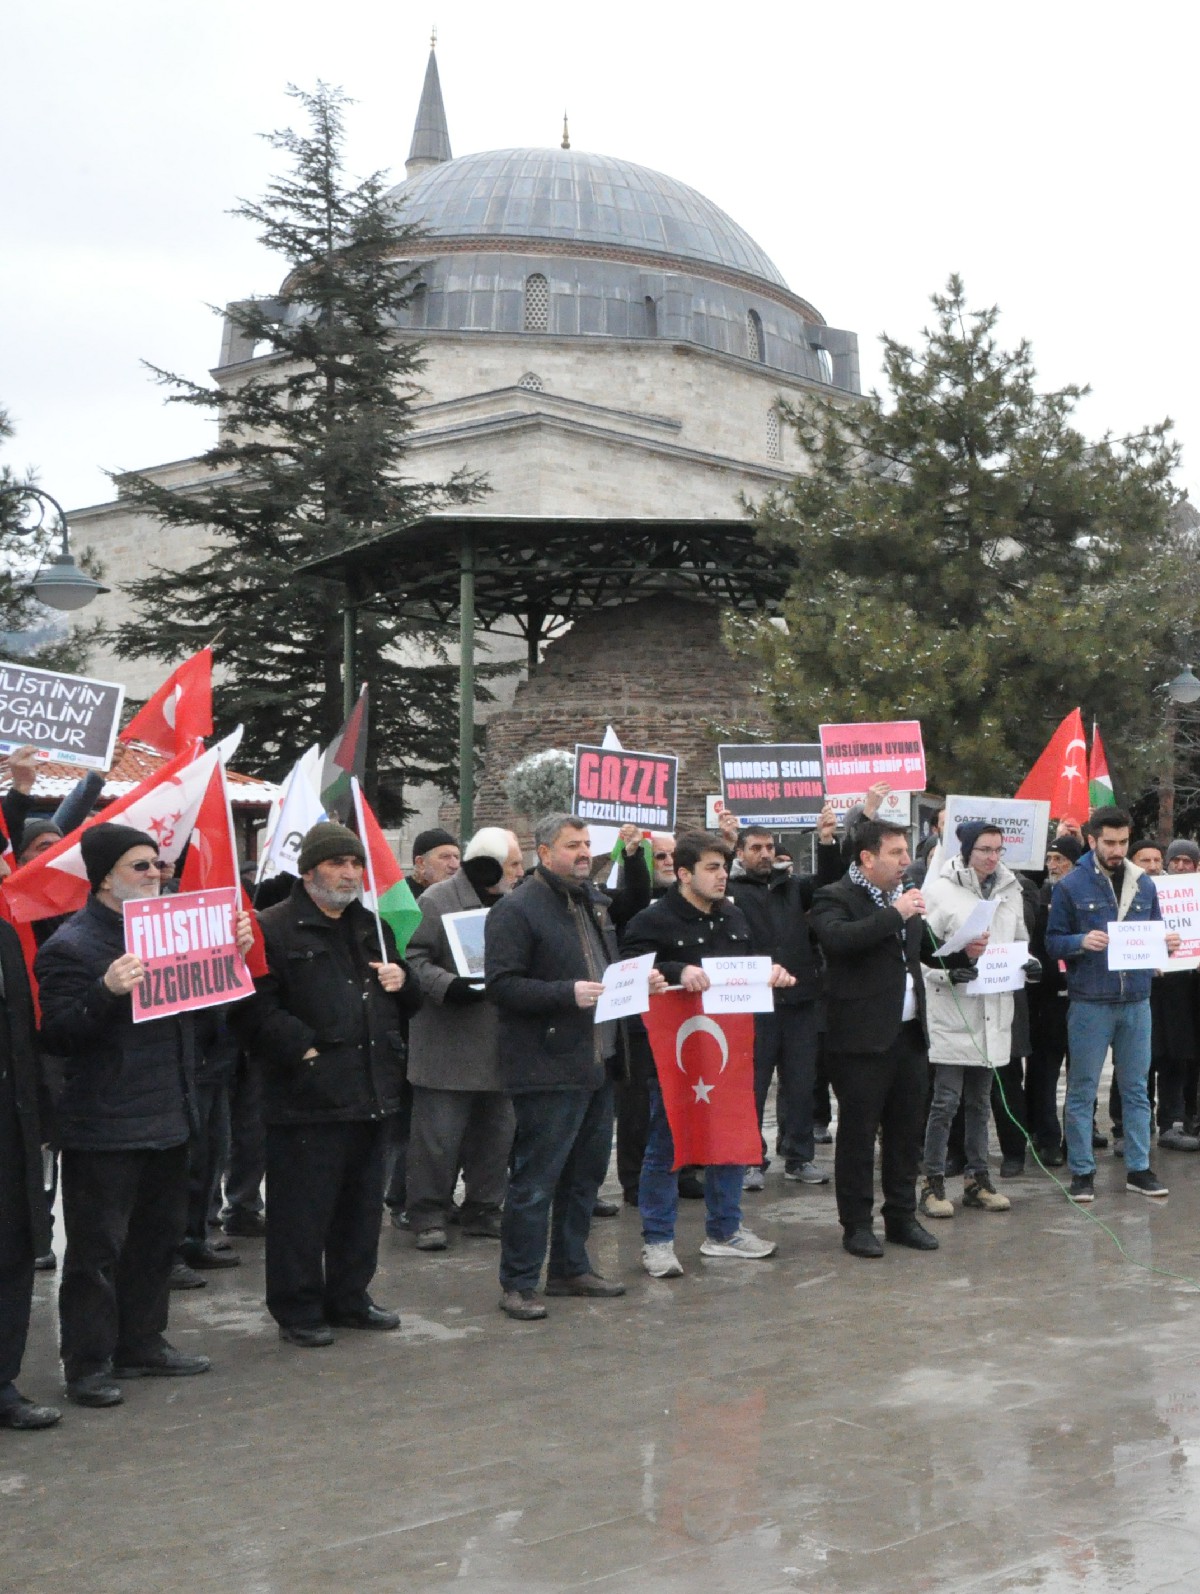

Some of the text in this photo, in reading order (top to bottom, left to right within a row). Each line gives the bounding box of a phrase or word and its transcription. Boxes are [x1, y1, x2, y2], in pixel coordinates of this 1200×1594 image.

[826, 741, 919, 758] MÜSLÜMAN UYUMA
[724, 761, 821, 779] HAMASA SELAM
[579, 752, 669, 806] GAZZE
[727, 780, 823, 802] DİRENİŞE DEVAM
[578, 800, 668, 826] GAZZELİLERİNDİR
[1158, 888, 1194, 899] SLAM
[131, 897, 235, 960] FİLİSTİNE
[1122, 952, 1151, 960] TRUMP
[716, 961, 758, 970] DON'T BE
[986, 961, 1008, 970] OLMA
[138, 948, 243, 1010] ÖZGÜRLÜK
[984, 975, 1010, 984] TRUMP
[720, 994, 752, 1003] TRUMP
